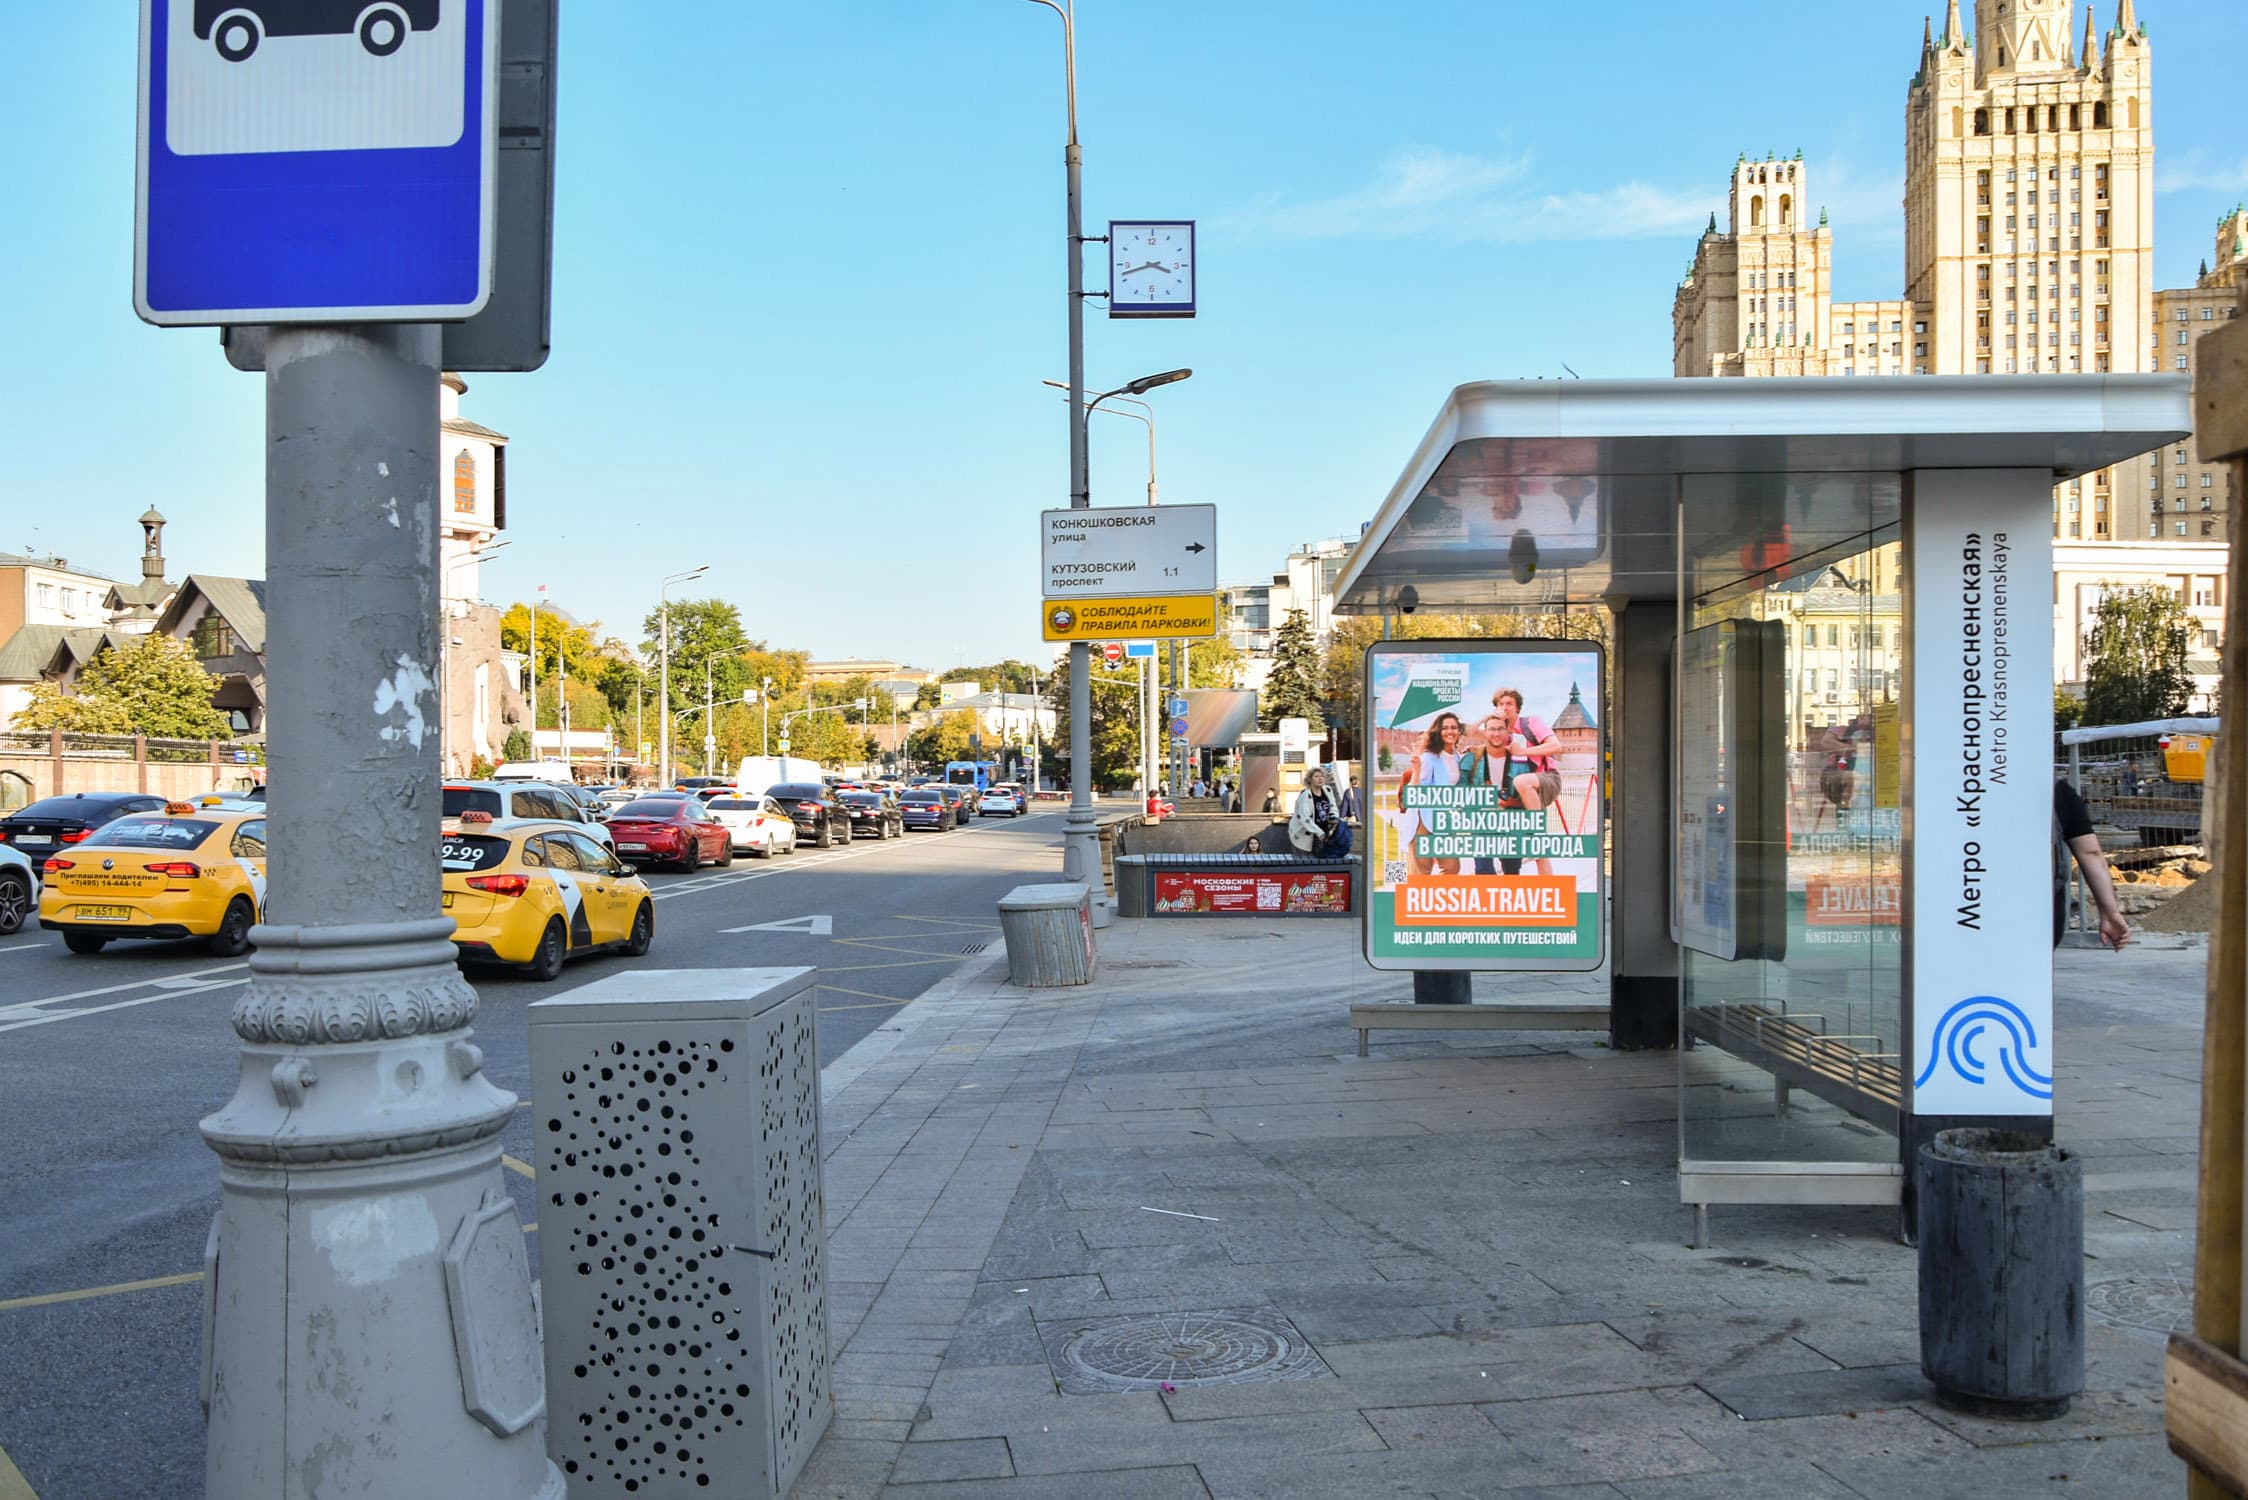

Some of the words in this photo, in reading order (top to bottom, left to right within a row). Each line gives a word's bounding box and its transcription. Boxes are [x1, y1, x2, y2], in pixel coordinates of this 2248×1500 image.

[1174, 262, 1180, 270] 3
[1149, 285, 1155, 293] 6
[1052, 516, 1156, 529] КОНЮШКОВСКАЯ
[1052, 533, 1087, 545] улица
[1052, 560, 1136, 574] КУТУЗОВСКИЙ
[1162, 567, 1179, 577] 1.1
[1052, 577, 1104, 588] проспект
[1081, 604, 1169, 618] СОБЛЮДАЙТЕ
[1081, 620, 1138, 631] ПРАВИЛА
[1141, 617, 1211, 630] ПАРКОВКИ!
[1989, 531, 2009, 722] Krasnopresnenskaya
[1956, 532, 1988, 827] «Краснопресненская»
[1432, 687, 1460, 695] ПРОЕКТЫ
[1437, 694, 1460, 703] РОССИИ
[1989, 726, 2009, 785] Metro
[1407, 786, 1495, 808] ВЫХОДИТЕ
[1437, 812, 1447, 831] В
[1451, 811, 1545, 833] ВЫХОДНЫЕ
[1420, 836, 1430, 855] В
[1433, 835, 1517, 857] СОСЕДНИЕ
[1521, 835, 1584, 857] ГОРОДА
[60, 872, 110, 880] Приглашаем
[71, 879, 100, 887] +7(495)
[1956, 842, 1988, 930] Метро
[1406, 887, 1566, 913] RUSSIA.TRAVEL
[96, 906, 113, 916] 651
[1394, 930, 1421, 945] ИДЕИ
[1424, 931, 1446, 945] ДЛЯ
[1448, 930, 1501, 945] КОРОТКИХ
[1503, 928, 1577, 945] ПУТЕШЕСТВИЙ
